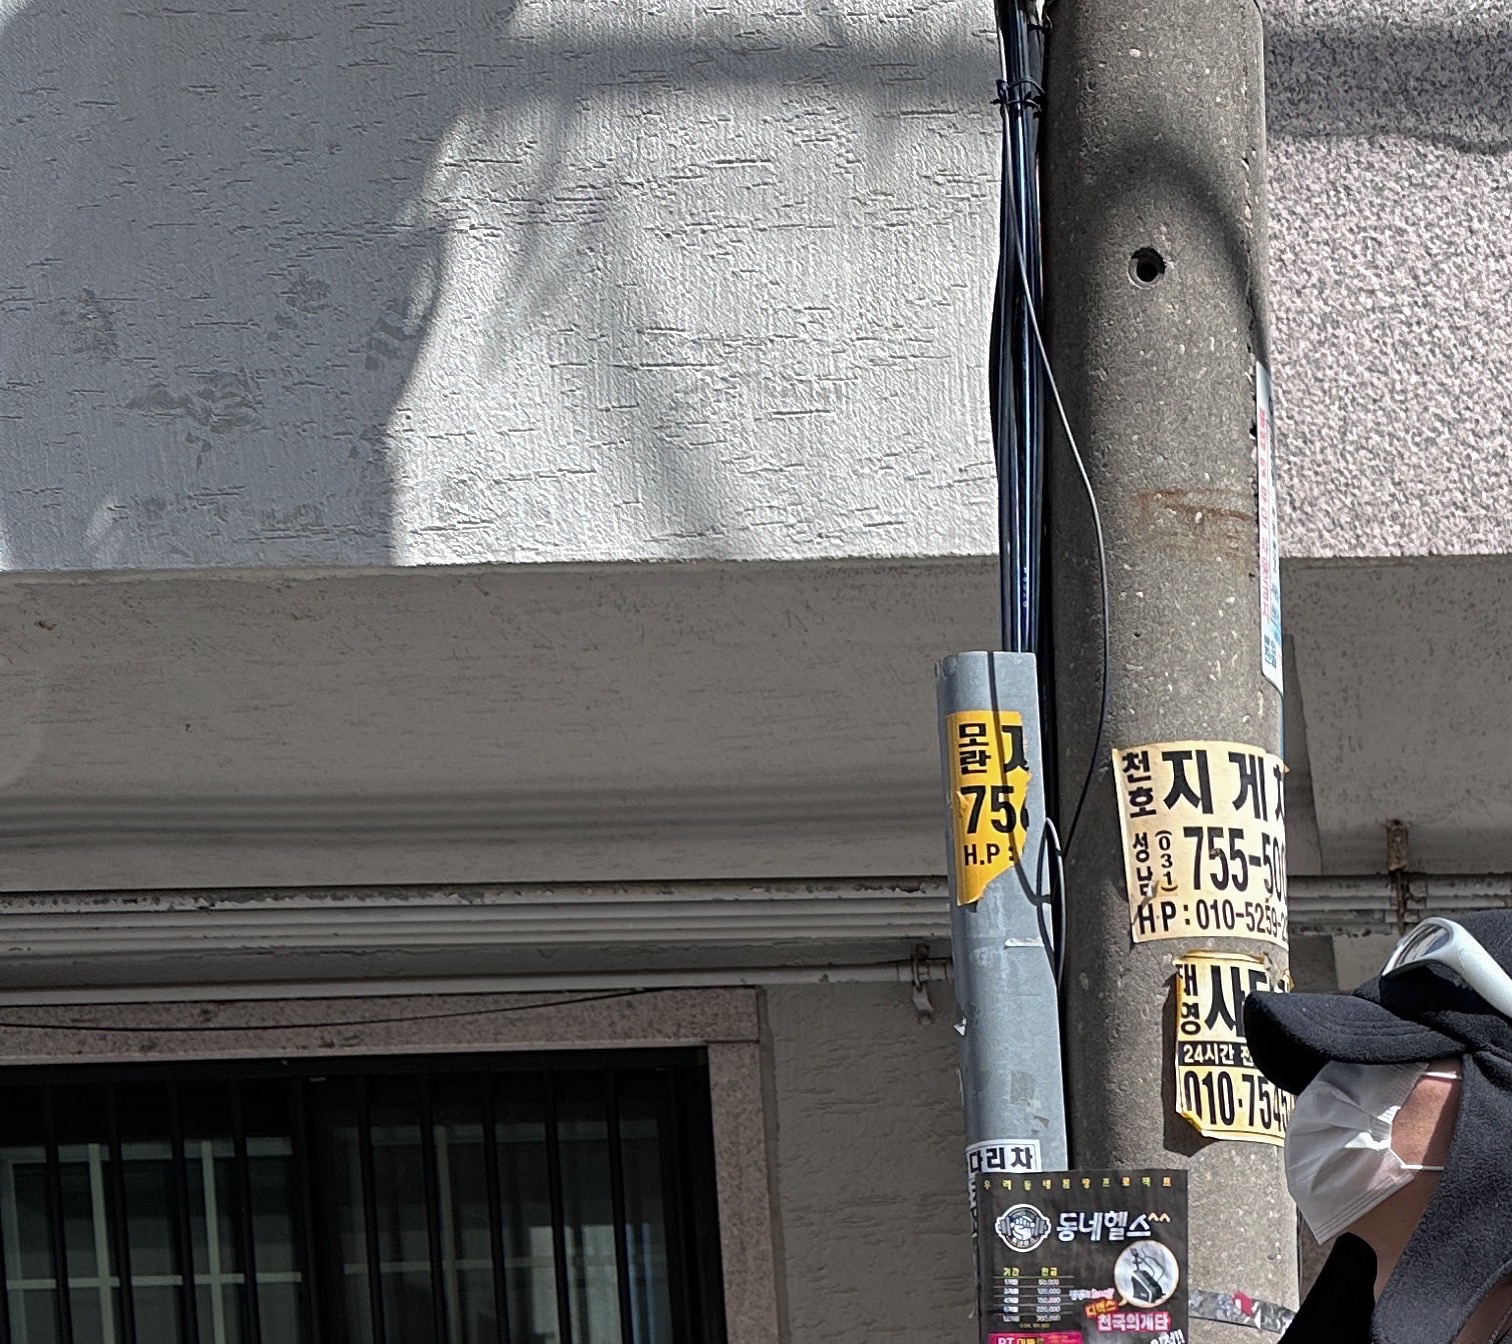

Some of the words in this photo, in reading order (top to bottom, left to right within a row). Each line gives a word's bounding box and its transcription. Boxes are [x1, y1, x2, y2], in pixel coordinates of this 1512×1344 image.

[959, 723, 991, 775] 모란
[1122, 751, 1157, 818] 천호
[1184, 1043, 1235, 1066] 24시간
